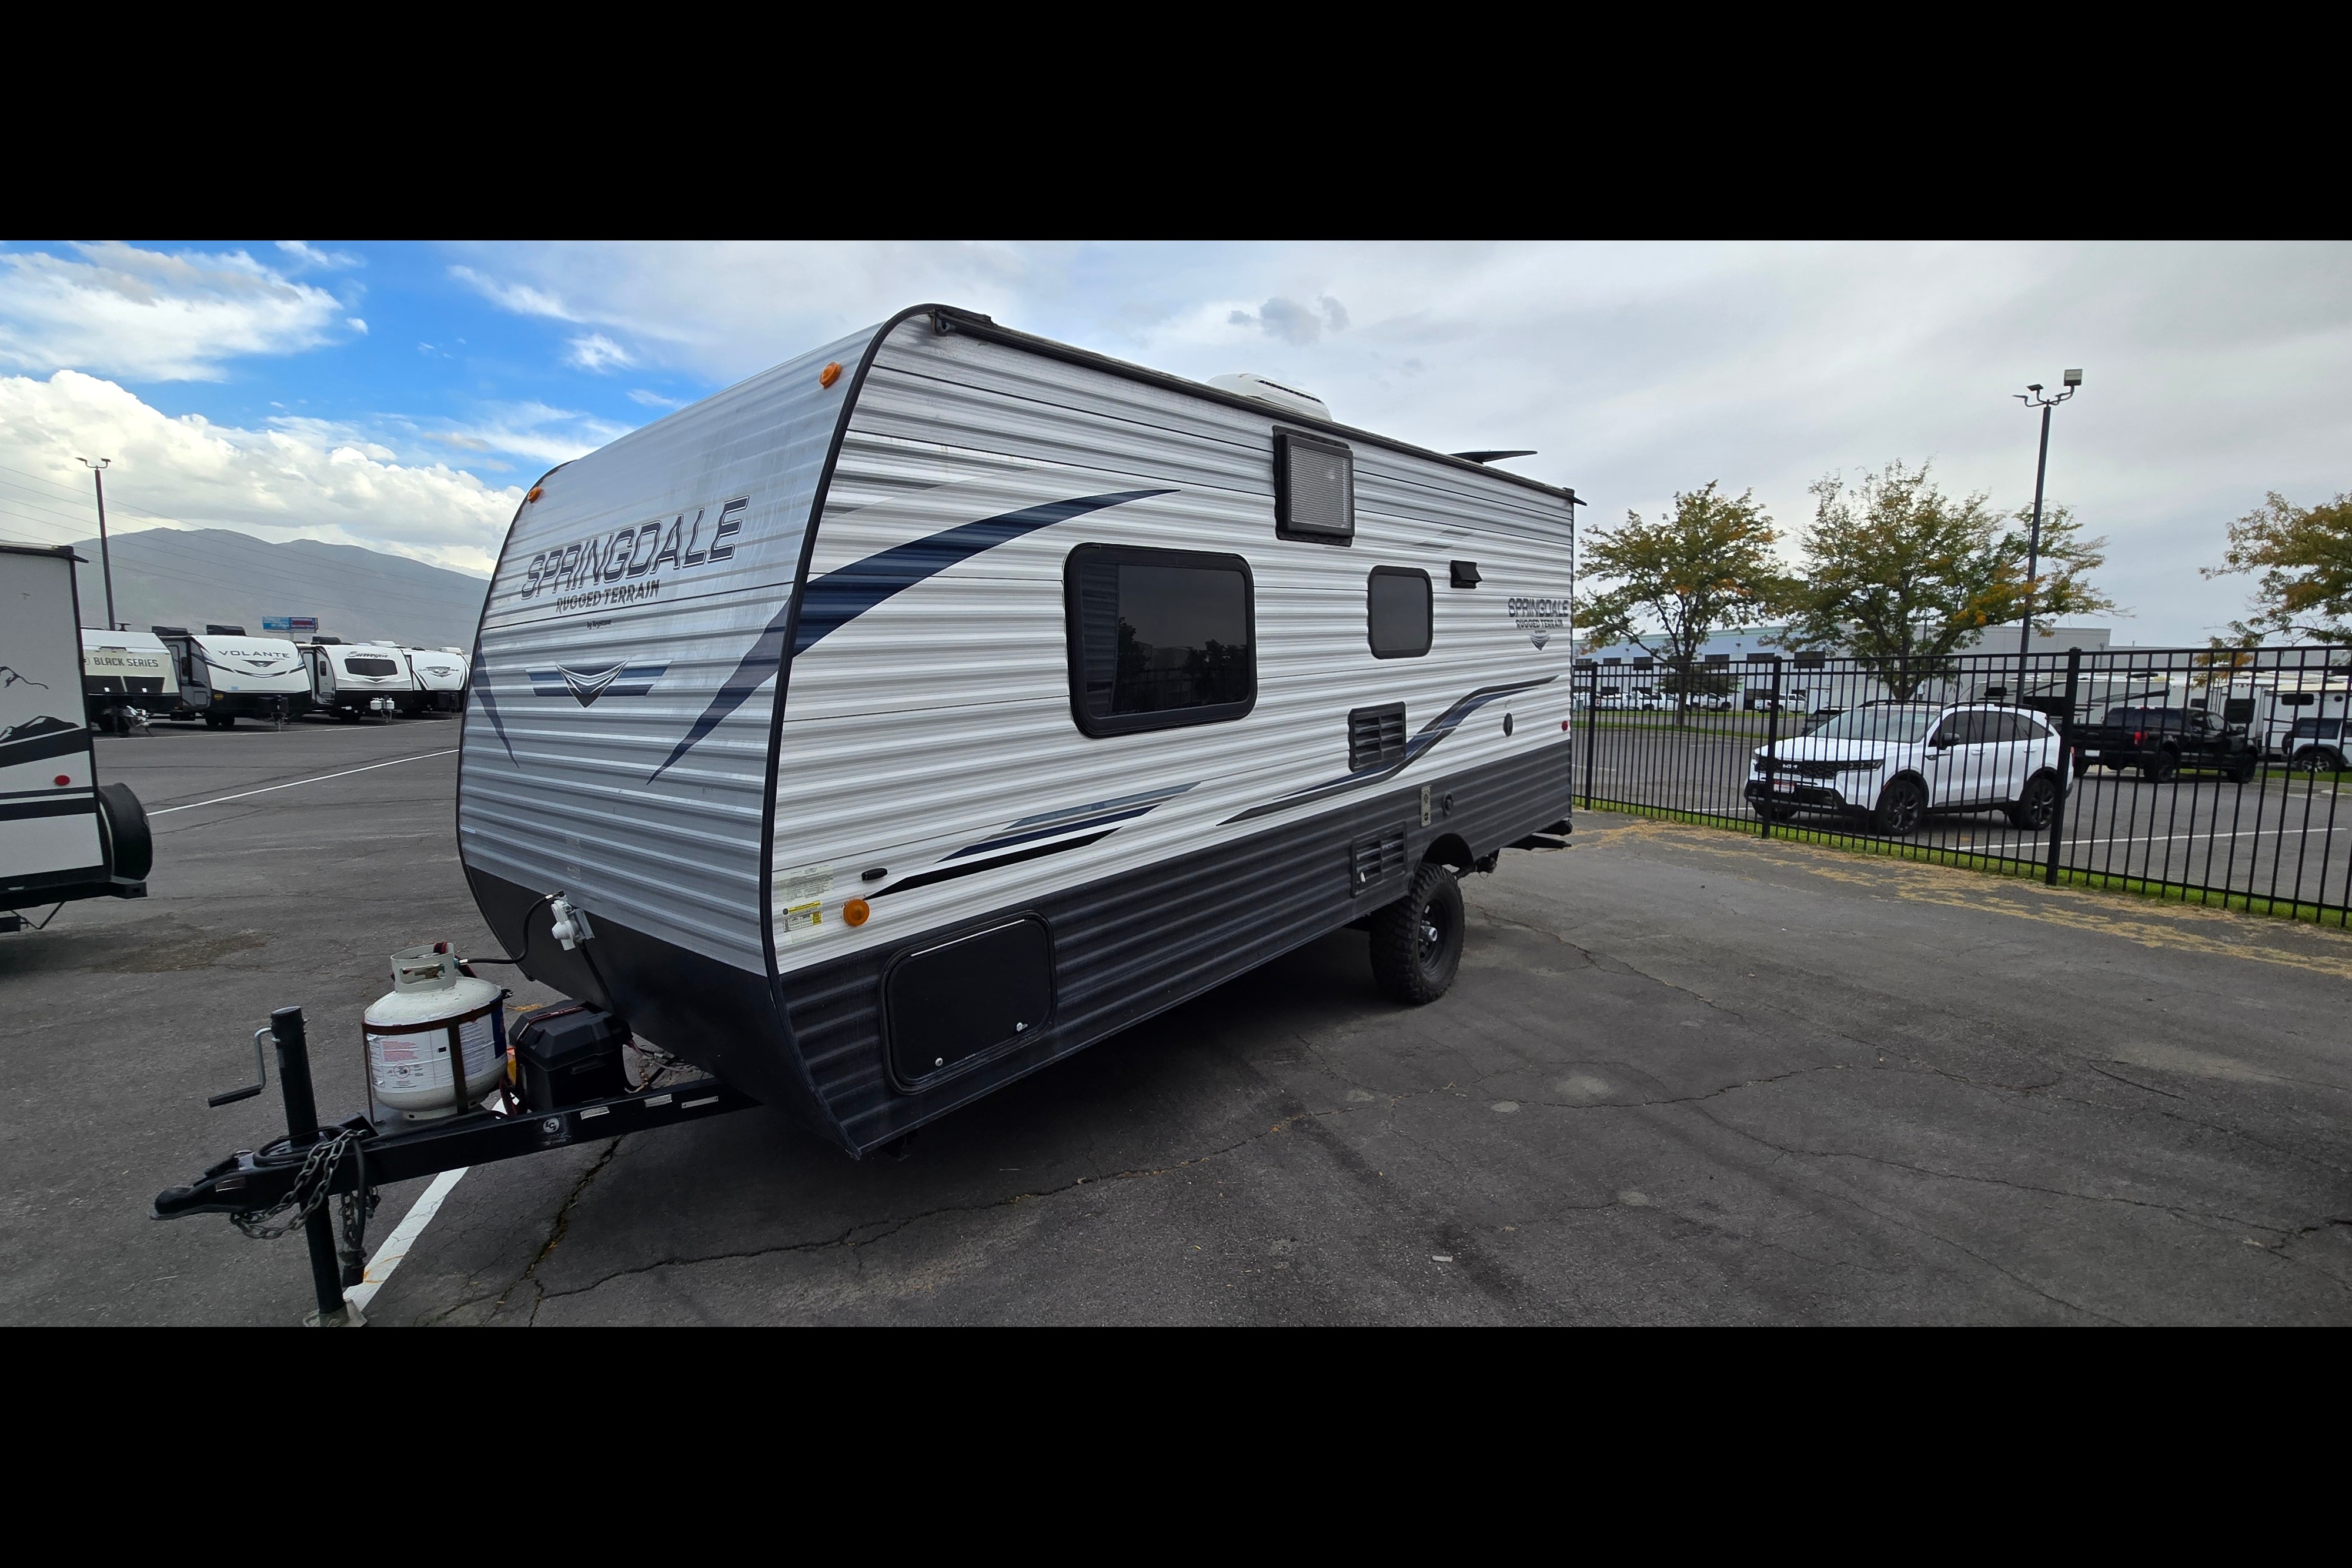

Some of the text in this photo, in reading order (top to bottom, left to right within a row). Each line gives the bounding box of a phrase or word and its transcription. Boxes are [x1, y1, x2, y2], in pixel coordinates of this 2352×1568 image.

[521, 495, 750, 600] SPRINGDALE
[556, 579, 660, 614] RUGGED TERRAIN
[1508, 597, 1569, 618] SPRINGDALE
[1516, 619, 1564, 630] RUGGED TERRAIN
[93, 657, 159, 667] BLACK SERIES
[218, 650, 291, 658] VOLANTE
